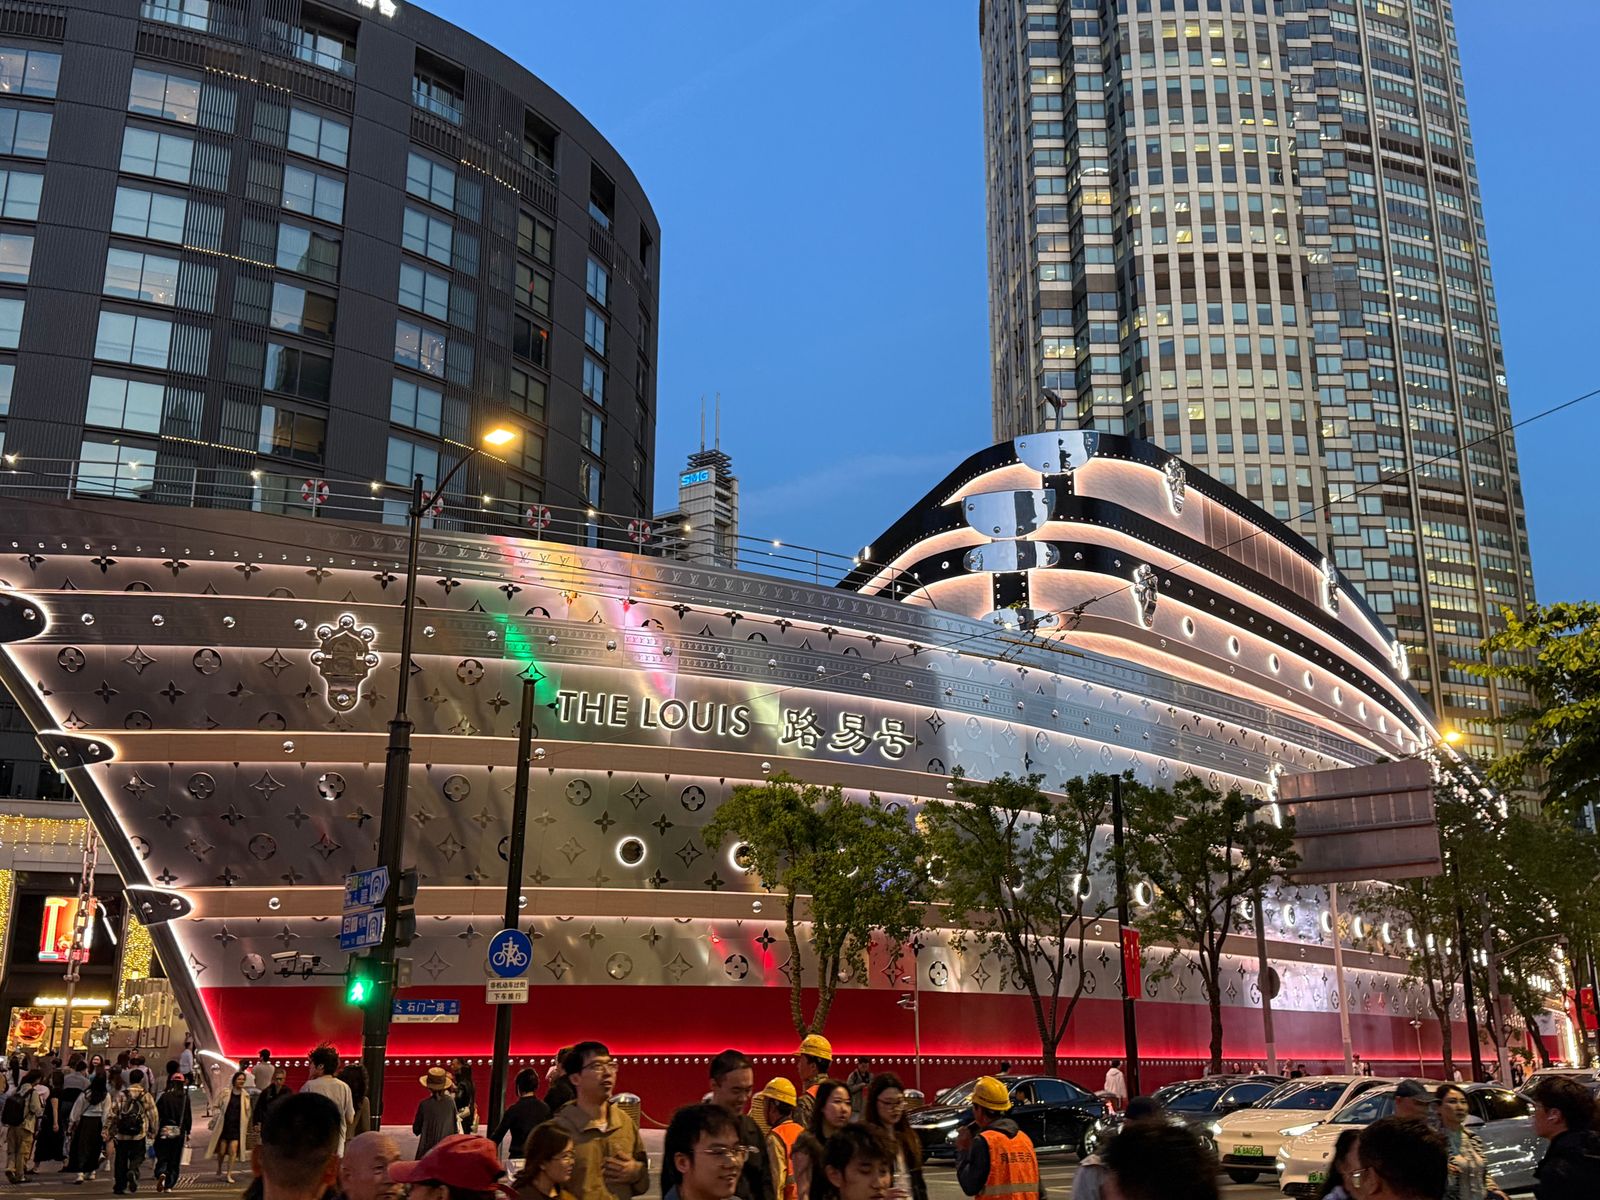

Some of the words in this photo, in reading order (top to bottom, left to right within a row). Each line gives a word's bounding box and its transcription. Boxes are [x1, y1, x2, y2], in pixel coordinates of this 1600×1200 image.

[681, 470, 709, 486] SMG
[557, 690, 629, 727] THE
[640, 696, 751, 737] LOUIS
[779, 707, 916, 760] 路易号
[407, 1002, 445, 1013] 石门一路
